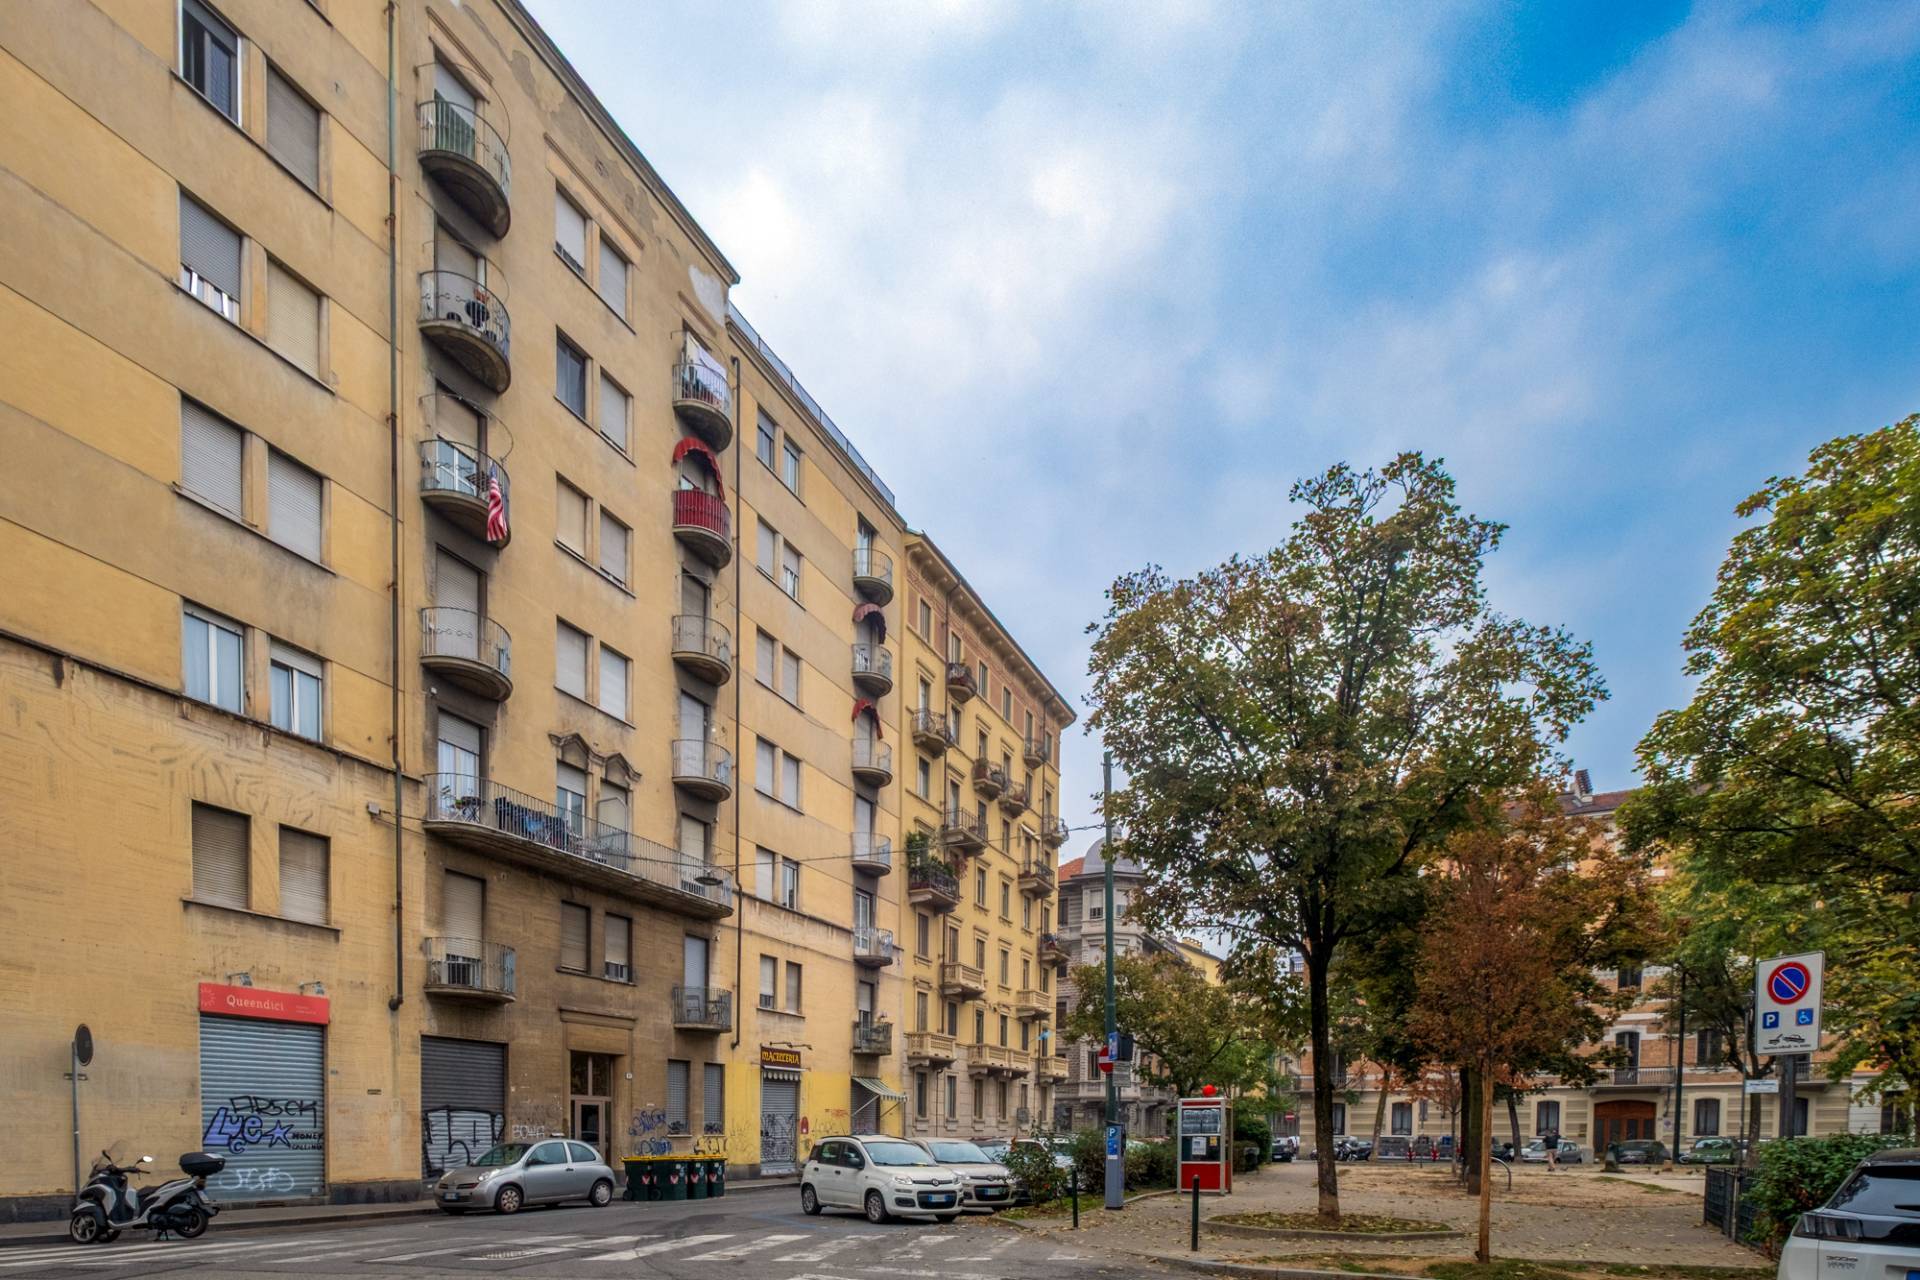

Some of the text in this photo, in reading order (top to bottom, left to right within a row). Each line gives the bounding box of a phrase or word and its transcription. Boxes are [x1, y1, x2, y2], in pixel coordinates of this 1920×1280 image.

[226, 994, 284, 1011] Queendici
[1766, 1014, 1776, 1026] P
[1109, 1127, 1117, 1137] P
